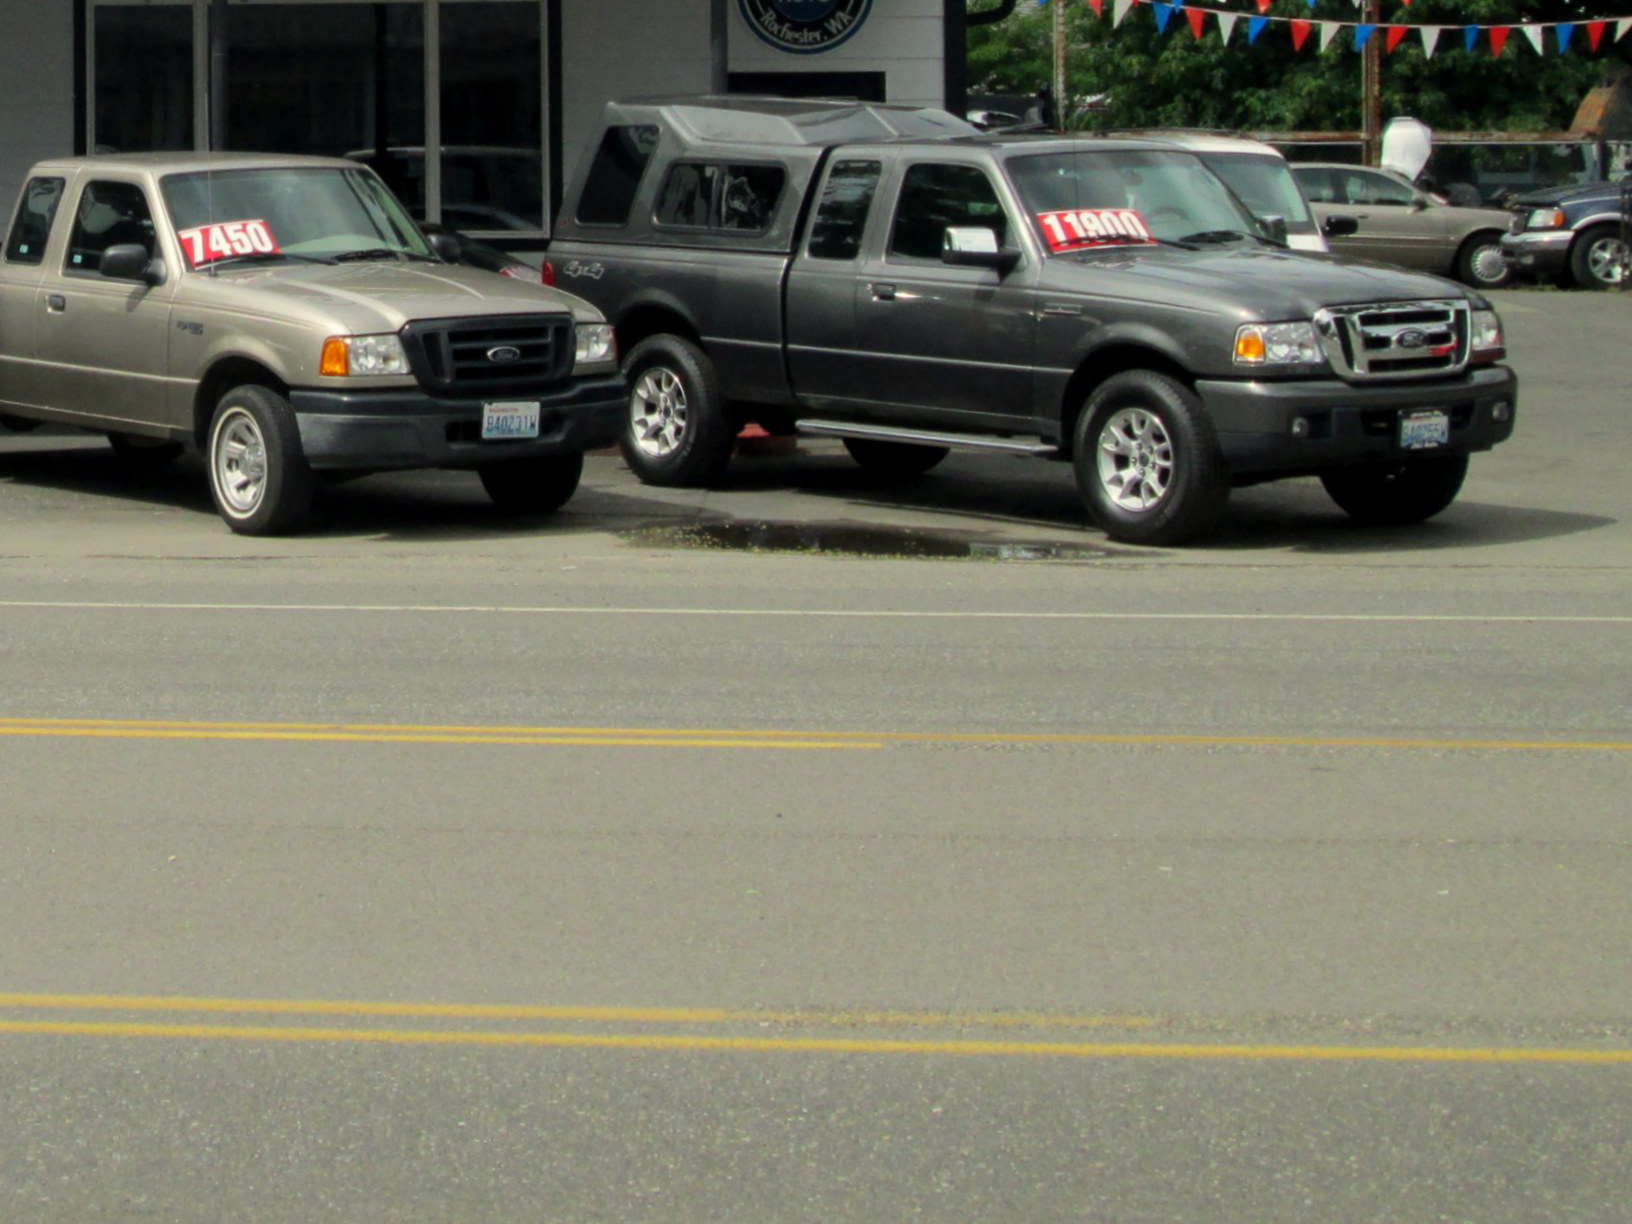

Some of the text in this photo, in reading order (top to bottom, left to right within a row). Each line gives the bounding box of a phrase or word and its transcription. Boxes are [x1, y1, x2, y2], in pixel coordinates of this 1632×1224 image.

[823, 10, 854, 35] WA
[179, 222, 275, 264] 7450
[1042, 211, 1150, 245] 11900
